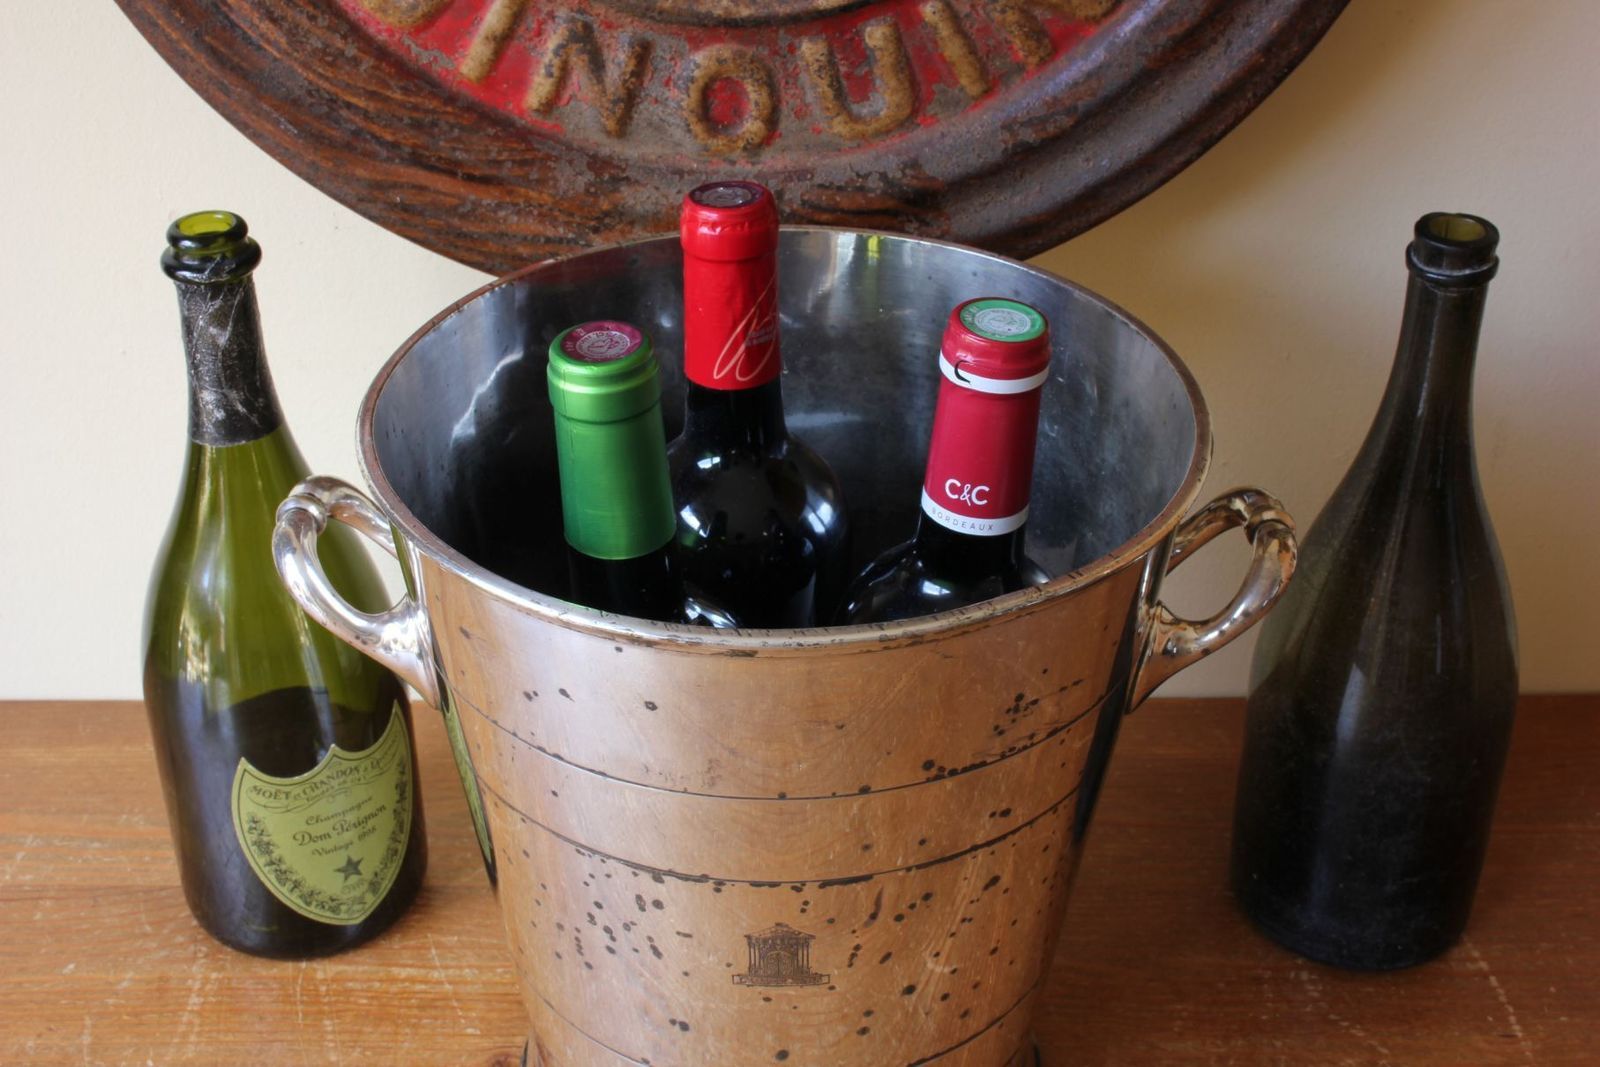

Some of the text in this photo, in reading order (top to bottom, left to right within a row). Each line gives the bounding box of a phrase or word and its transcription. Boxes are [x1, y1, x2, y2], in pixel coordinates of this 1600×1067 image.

[945, 479, 990, 506] C&C
[932, 507, 994, 531] BORDEAUX
[250, 785, 292, 800] MOËT
[292, 830, 332, 846] Dom
